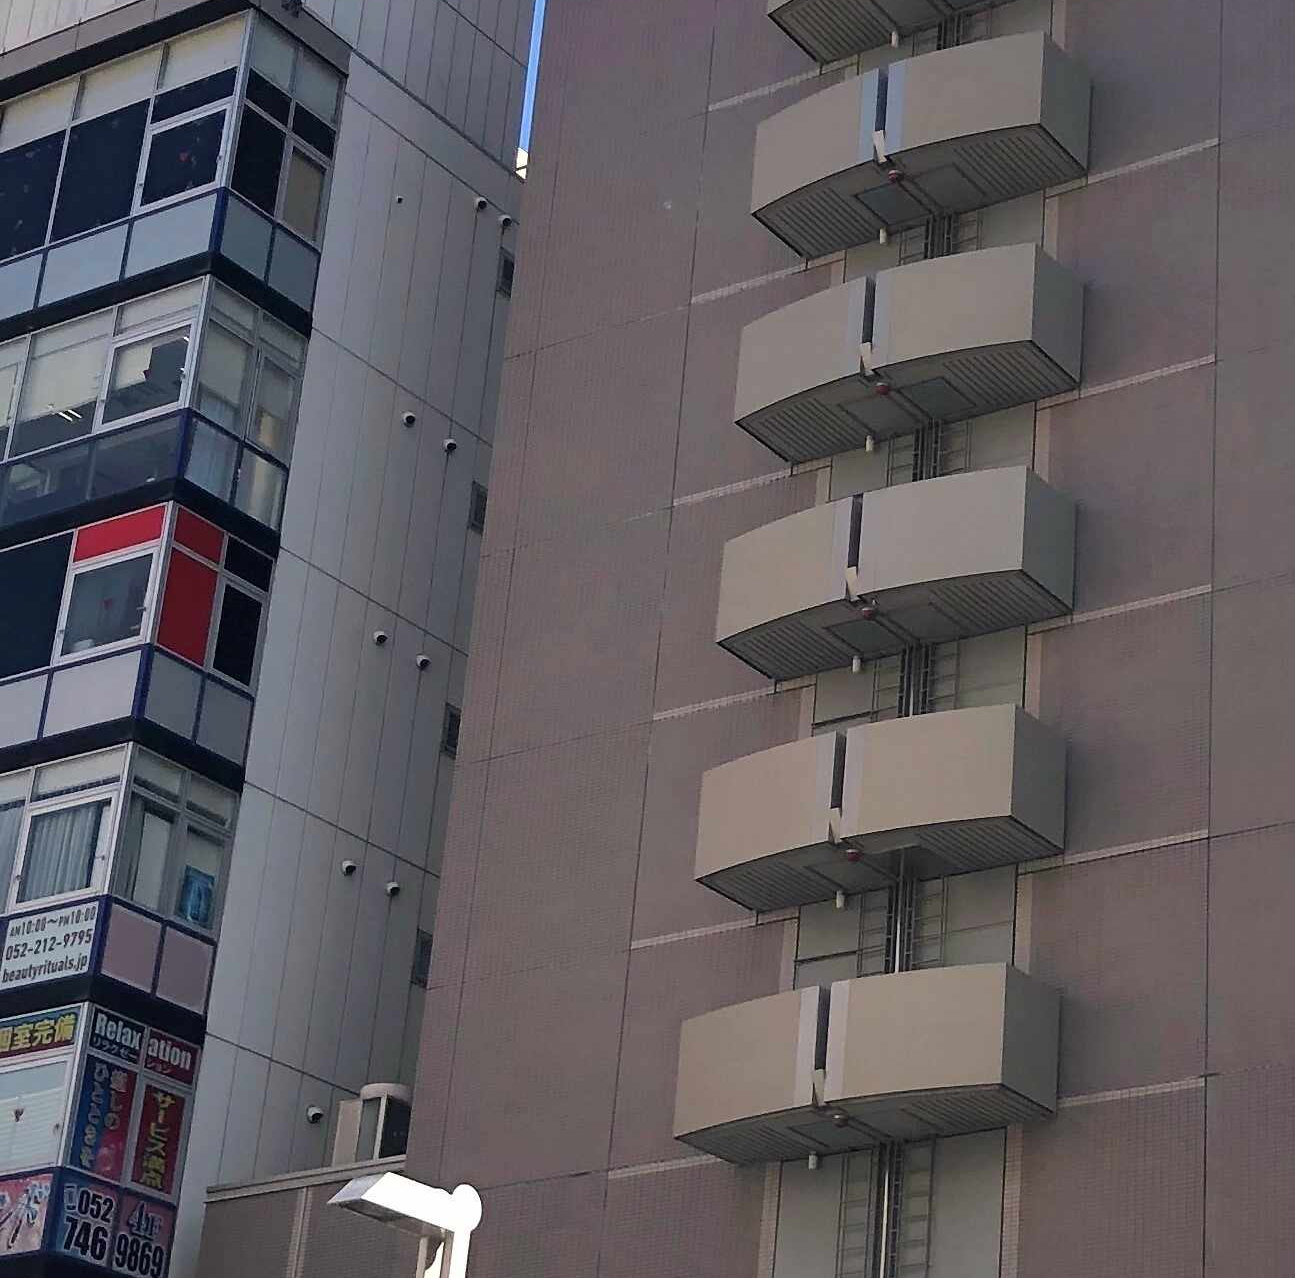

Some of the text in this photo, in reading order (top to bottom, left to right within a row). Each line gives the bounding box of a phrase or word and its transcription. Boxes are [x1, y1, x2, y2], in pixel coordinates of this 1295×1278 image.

[6, 928, 93, 961] 052-212-9795
[2, 953, 88, 983] beautyrituals.jp
[95, 1012, 141, 1050] Relax
[78, 1189, 114, 1223] 052
[64, 1215, 164, 1278] 746 9869
